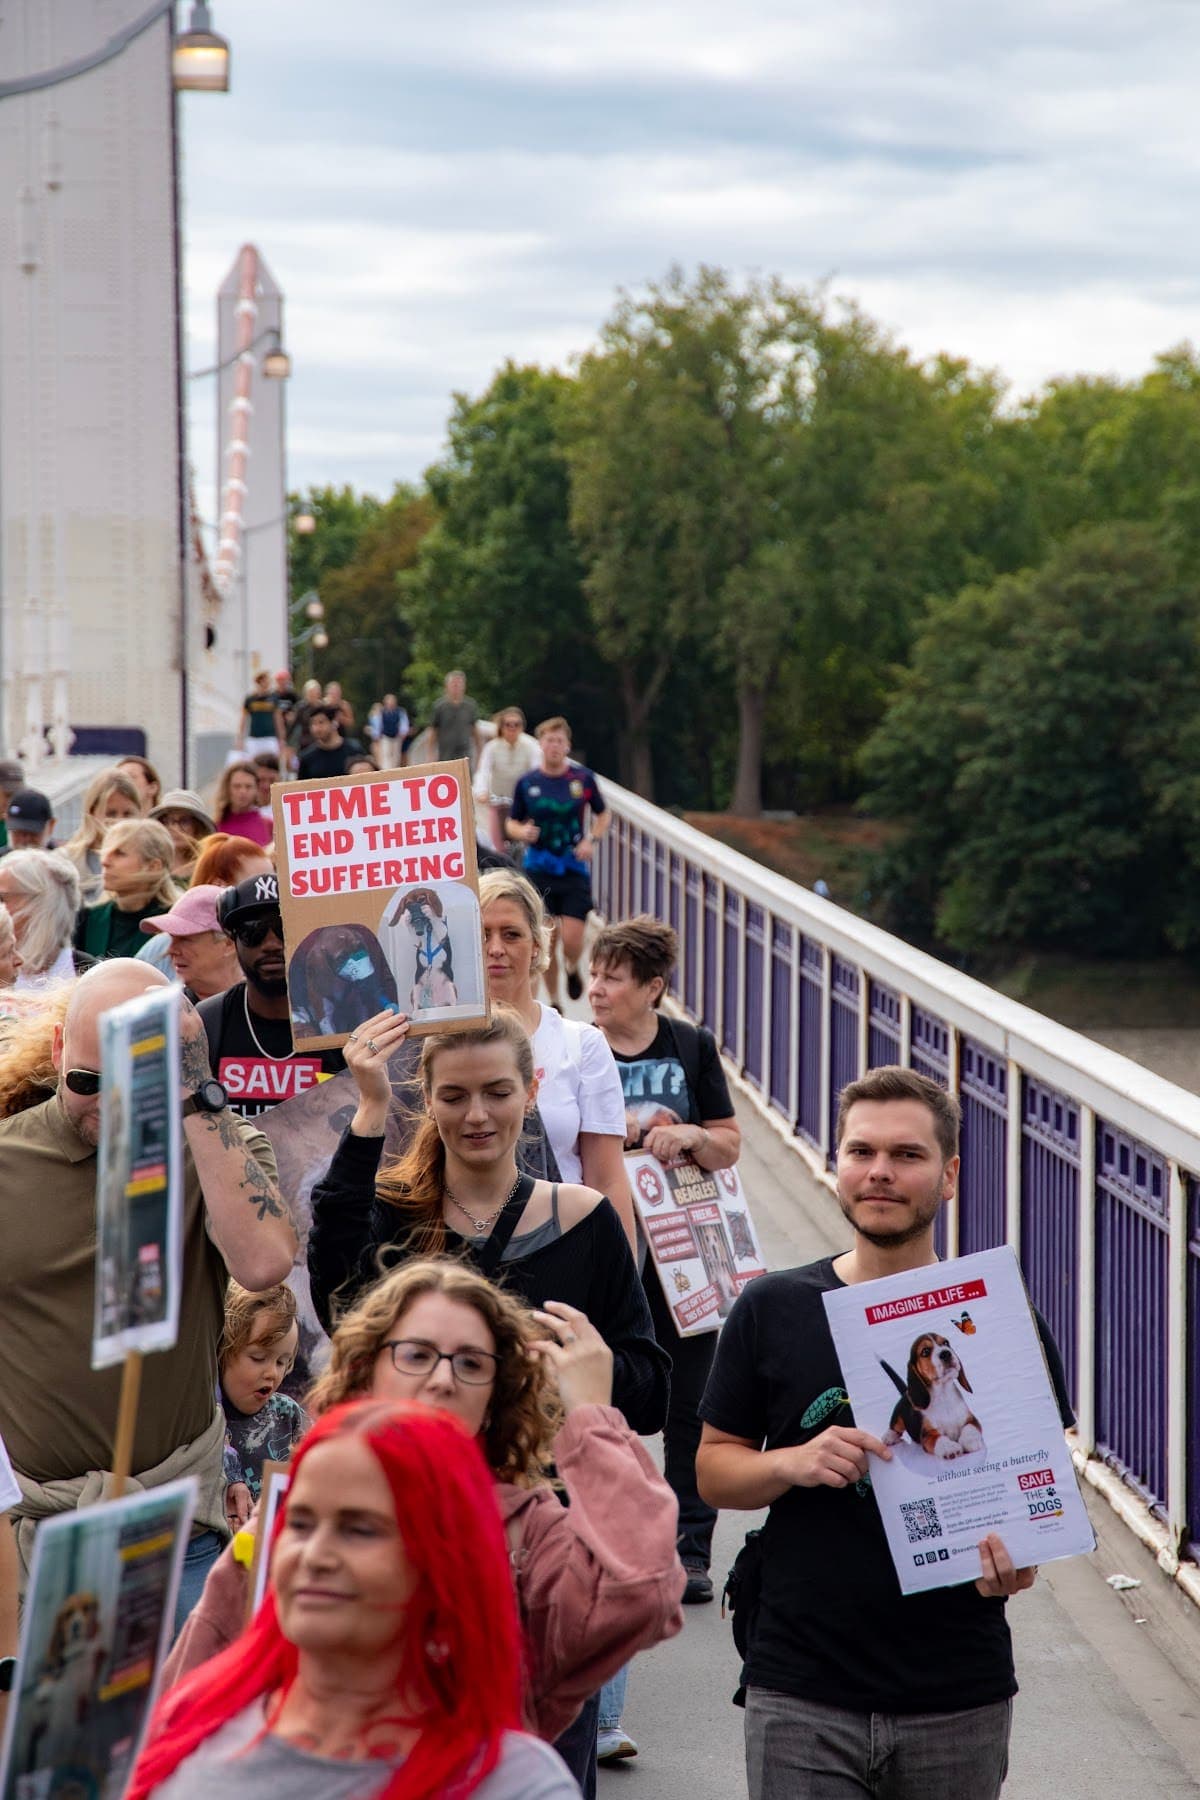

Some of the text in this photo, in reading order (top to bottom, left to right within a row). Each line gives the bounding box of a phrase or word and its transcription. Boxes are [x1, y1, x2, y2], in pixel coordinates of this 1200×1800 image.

[283, 774, 458, 826] TIME TO
[293, 817, 458, 859] END THEIR
[291, 852, 464, 897] SUFFERING
[223, 1063, 314, 1094] SAVE
[614, 1063, 686, 1097] HY?
[673, 1181, 718, 1205] BEAGLES!
[872, 1296, 926, 1321] IMAGINE
[927, 1294, 937, 1307] A
[938, 1286, 966, 1304] LIFE
[937, 1470, 971, 1483] without
[973, 1463, 1001, 1474] seeing
[1002, 1460, 1009, 1468] a
[1010, 1449, 1050, 1466] butterfly
[1020, 1470, 1053, 1489] SAVE
[1024, 1489, 1045, 1501] THE
[1027, 1498, 1063, 1515] DOGS
